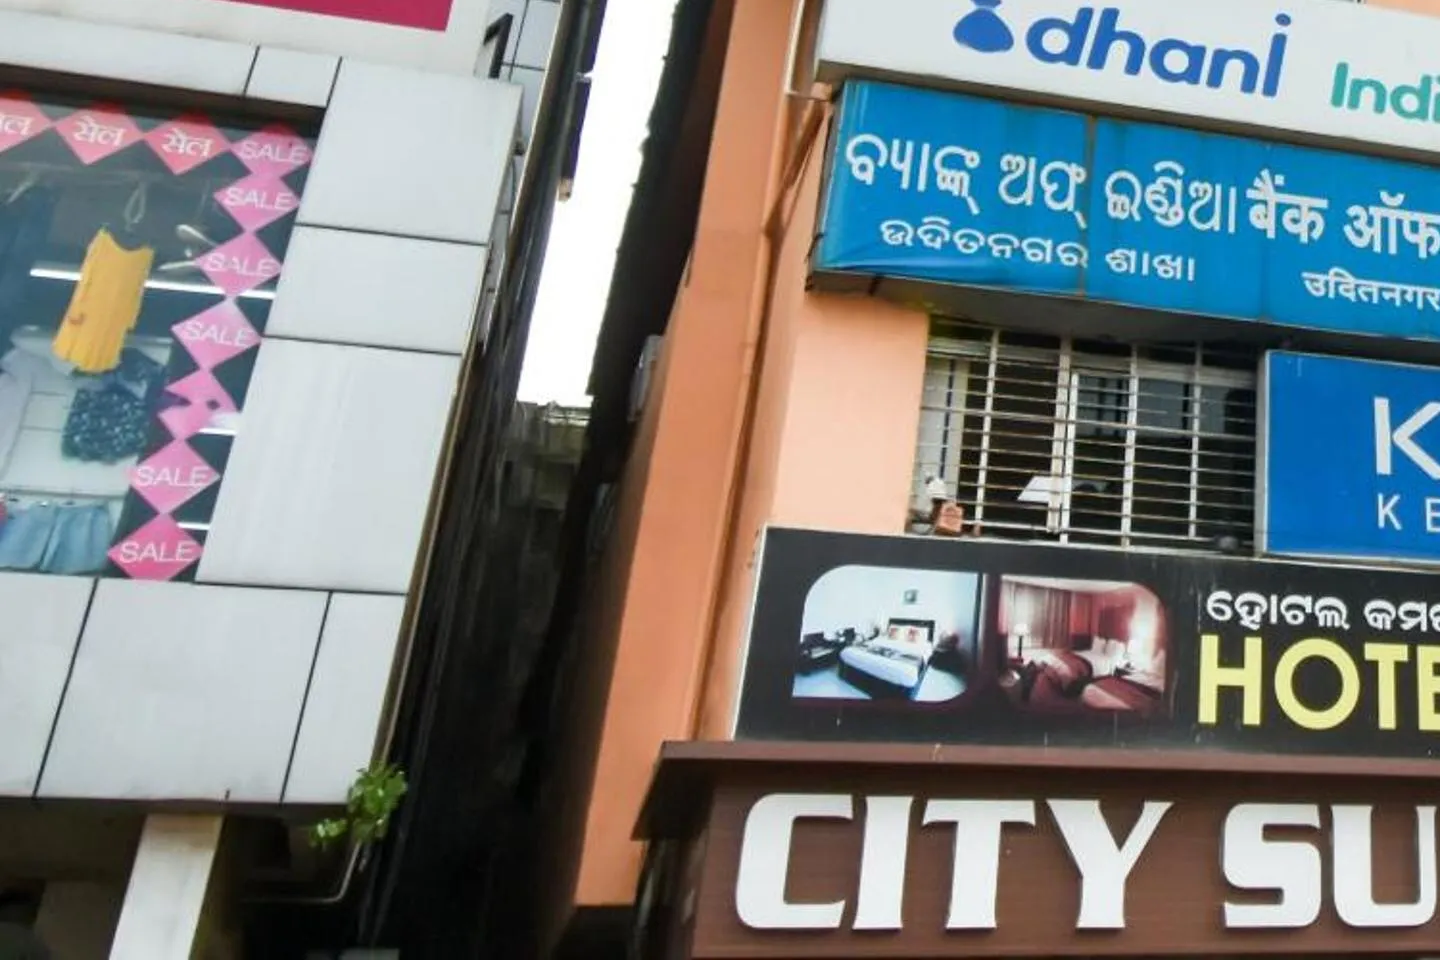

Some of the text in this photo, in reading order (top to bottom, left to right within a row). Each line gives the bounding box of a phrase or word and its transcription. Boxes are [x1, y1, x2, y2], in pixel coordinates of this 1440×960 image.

[1025, 7, 1290, 98] dhani
[73, 114, 127, 147] सेल
[161, 127, 215, 158] सेल
[239, 141, 310, 162] SALE
[226, 187, 294, 211] SALE
[1246, 168, 1329, 244] बैंक
[207, 253, 281, 276] SALE
[182, 320, 256, 347] SALE
[135, 465, 211, 488] SALE
[118, 541, 200, 564] SALE
[735, 794, 1174, 930] CITY
